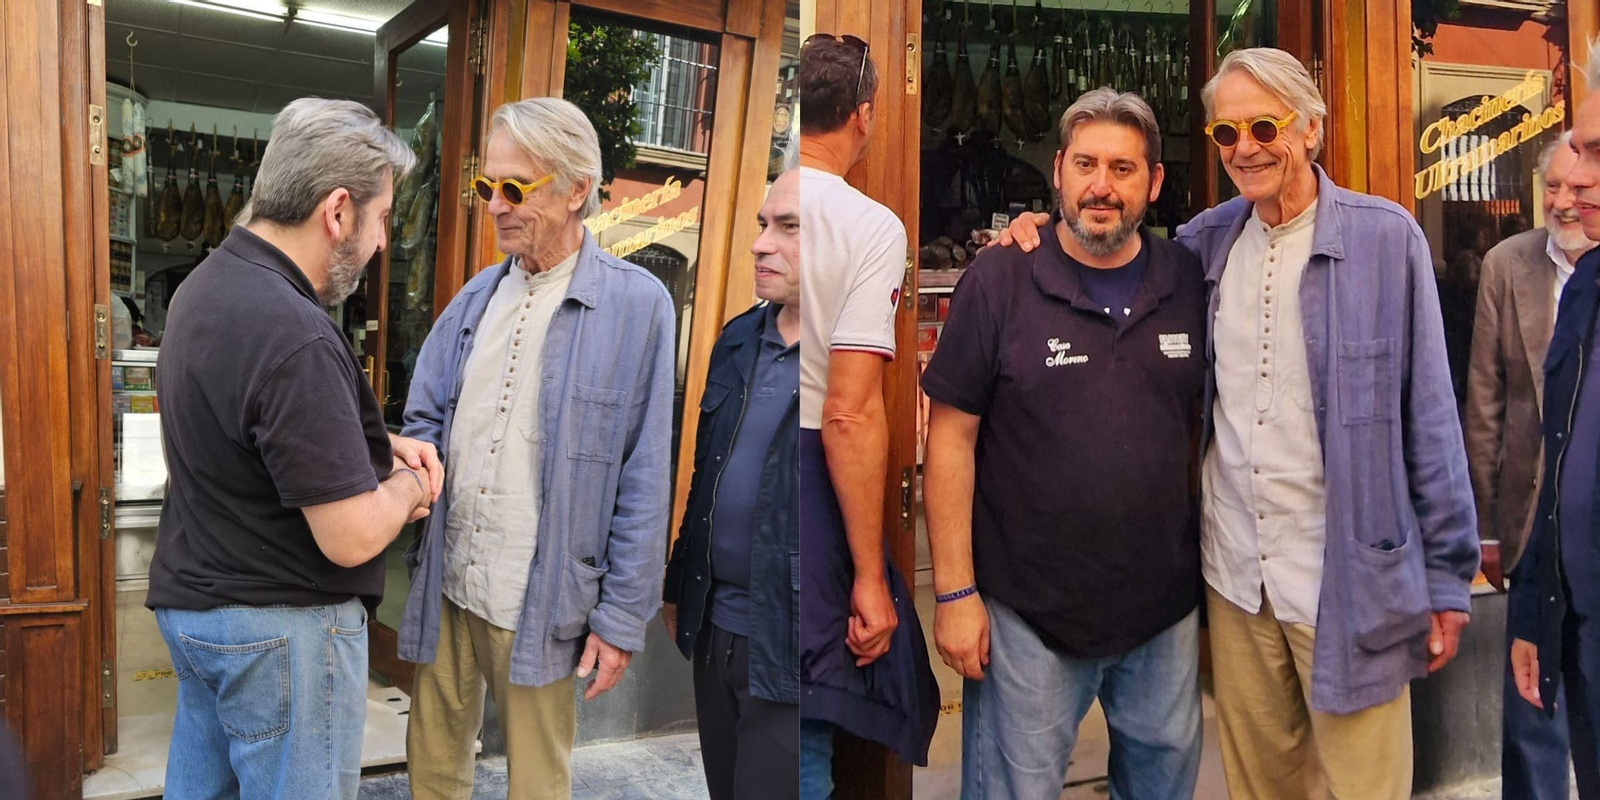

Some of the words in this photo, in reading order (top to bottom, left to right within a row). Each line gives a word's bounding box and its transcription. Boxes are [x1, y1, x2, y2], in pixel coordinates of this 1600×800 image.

[1420, 69, 1545, 154] Chacinería
[1414, 99, 1565, 200] Ultramarinos
[583, 175, 682, 235] acinería
[603, 205, 699, 259] marinos
[1045, 351, 1089, 367] Moreno
[1047, 338, 1071, 352] Casa
